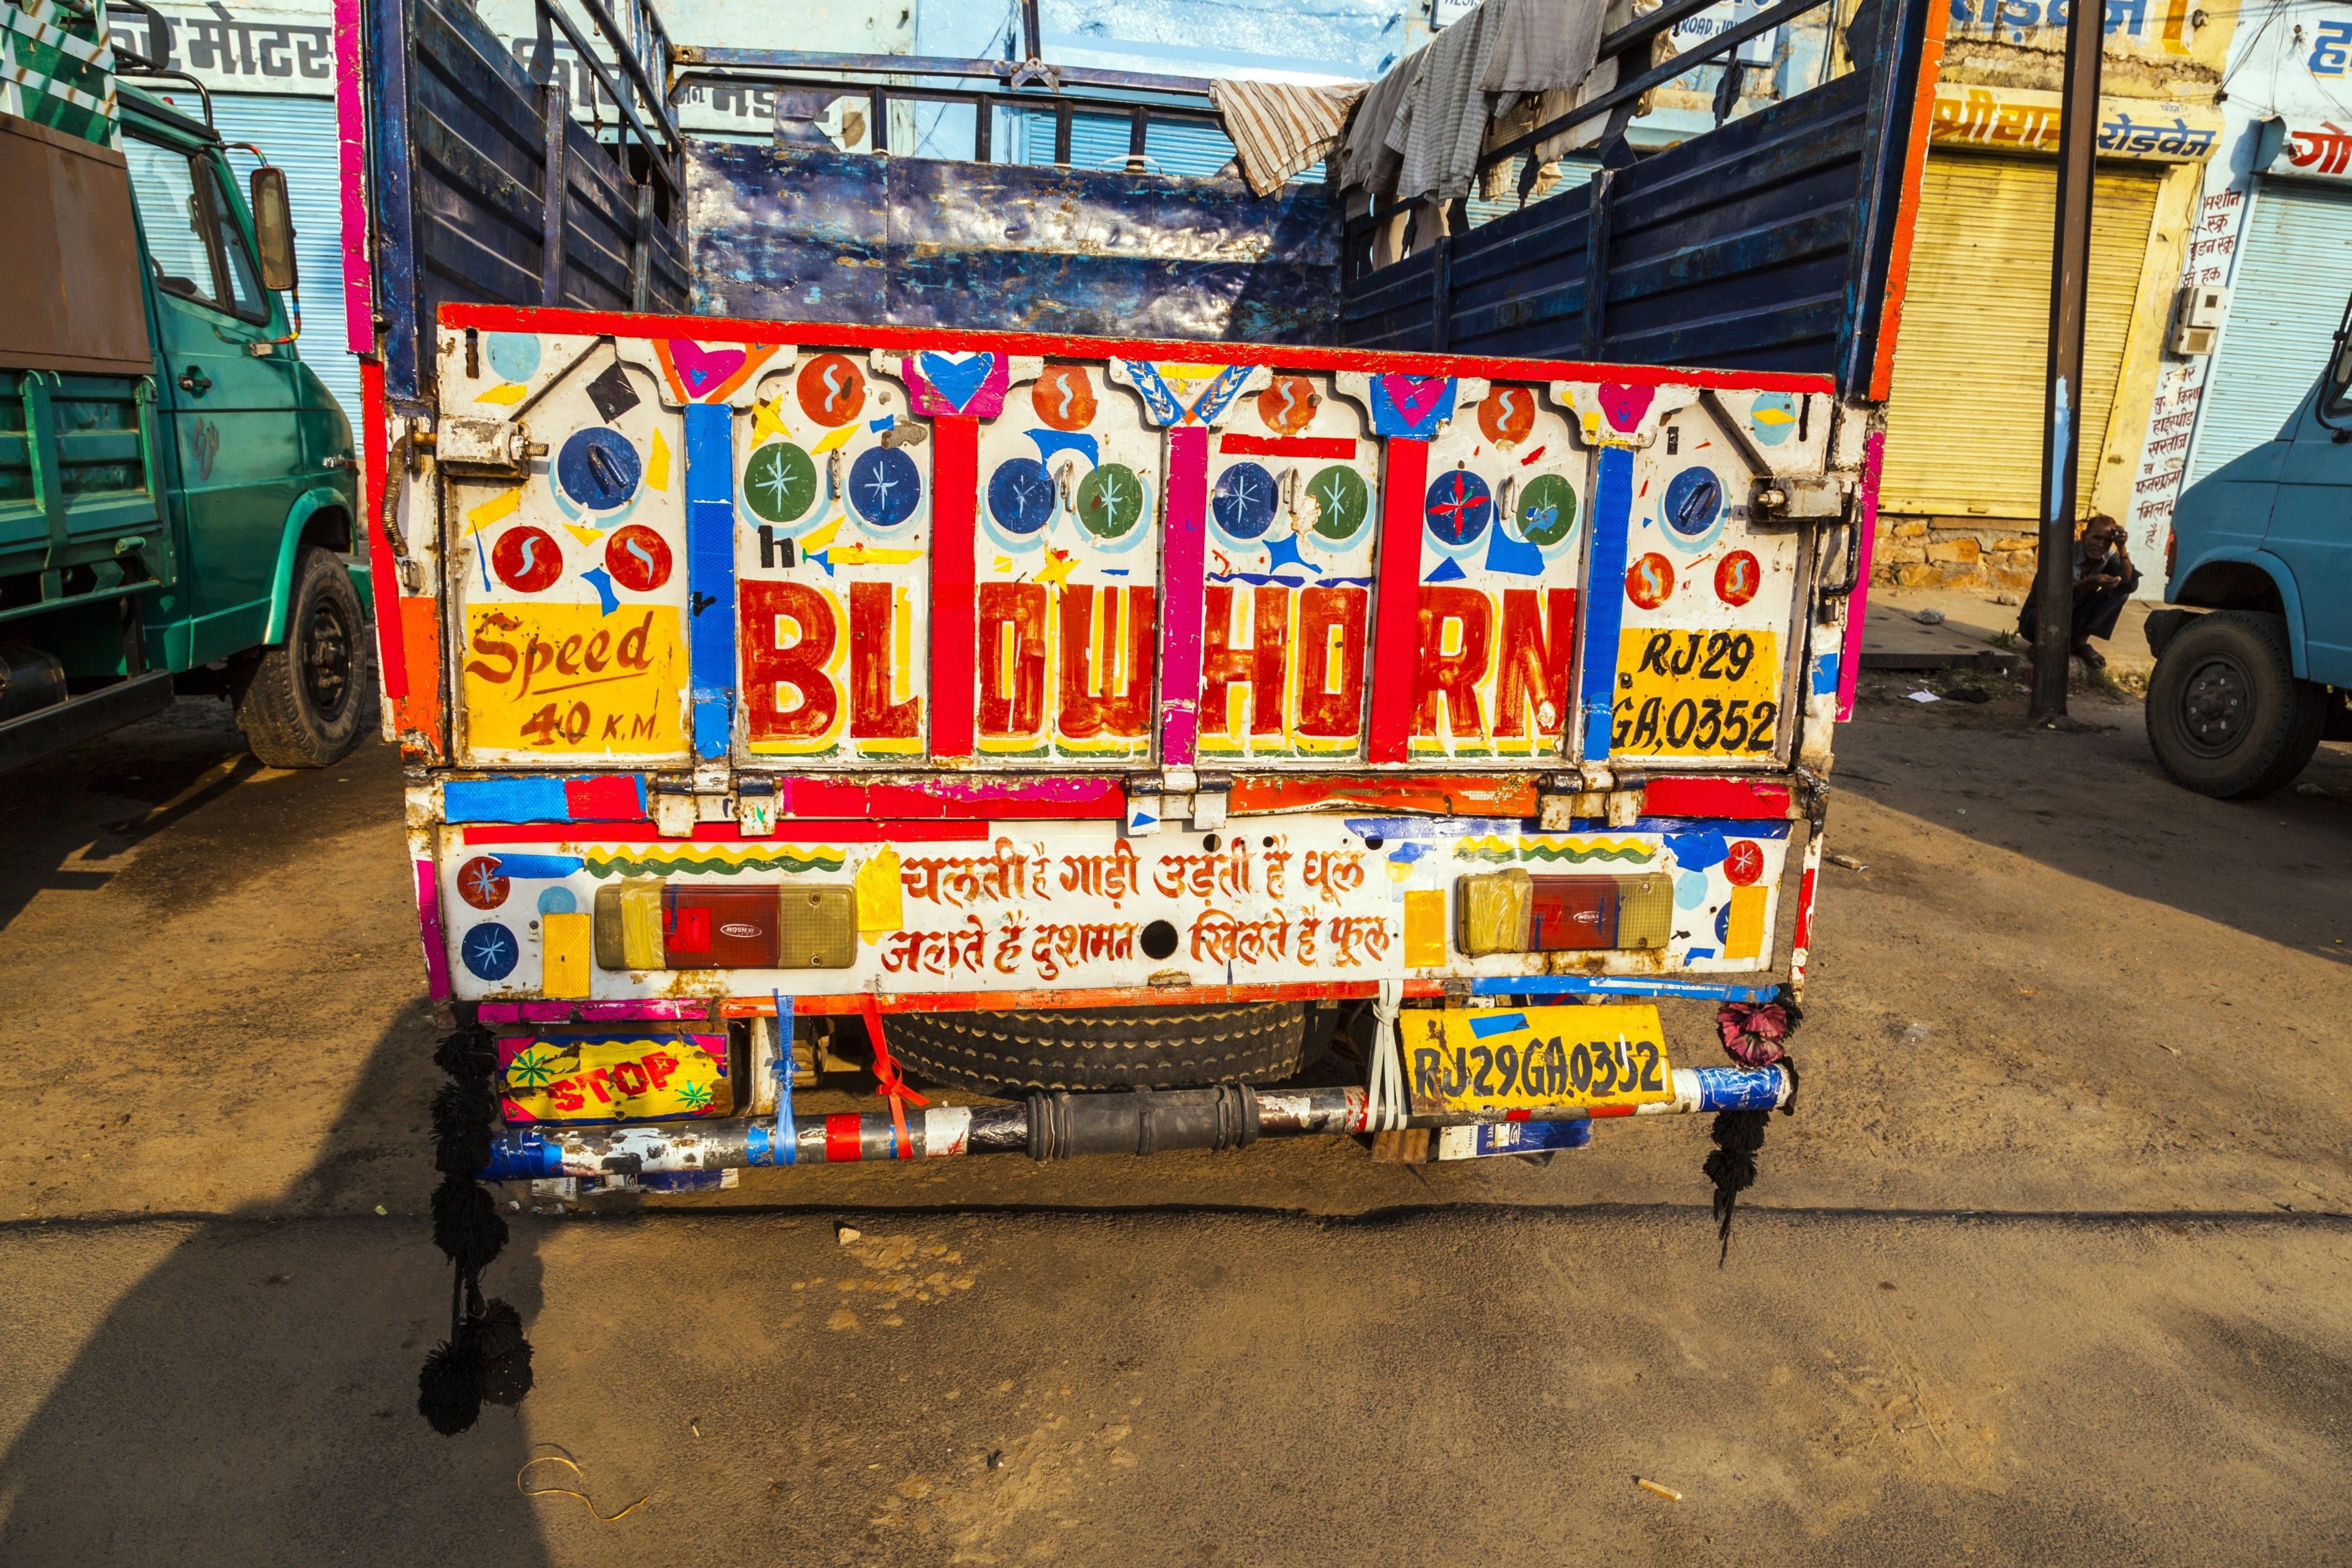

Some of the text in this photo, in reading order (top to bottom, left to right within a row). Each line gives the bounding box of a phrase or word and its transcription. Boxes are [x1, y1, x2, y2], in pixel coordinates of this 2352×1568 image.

[465, 610, 655, 703] Speed
[520, 701, 591, 746] 40
[900, 836, 1030, 909] चलती
[1059, 837, 1142, 909] गाड़ी
[1153, 836, 1258, 907] उड़ती
[1303, 850, 1367, 907] धूल
[881, 914, 993, 976] जलते
[1186, 908, 1294, 967] खिलते
[1328, 915, 1390, 968] फूल
[546, 1051, 680, 1112] STOP
